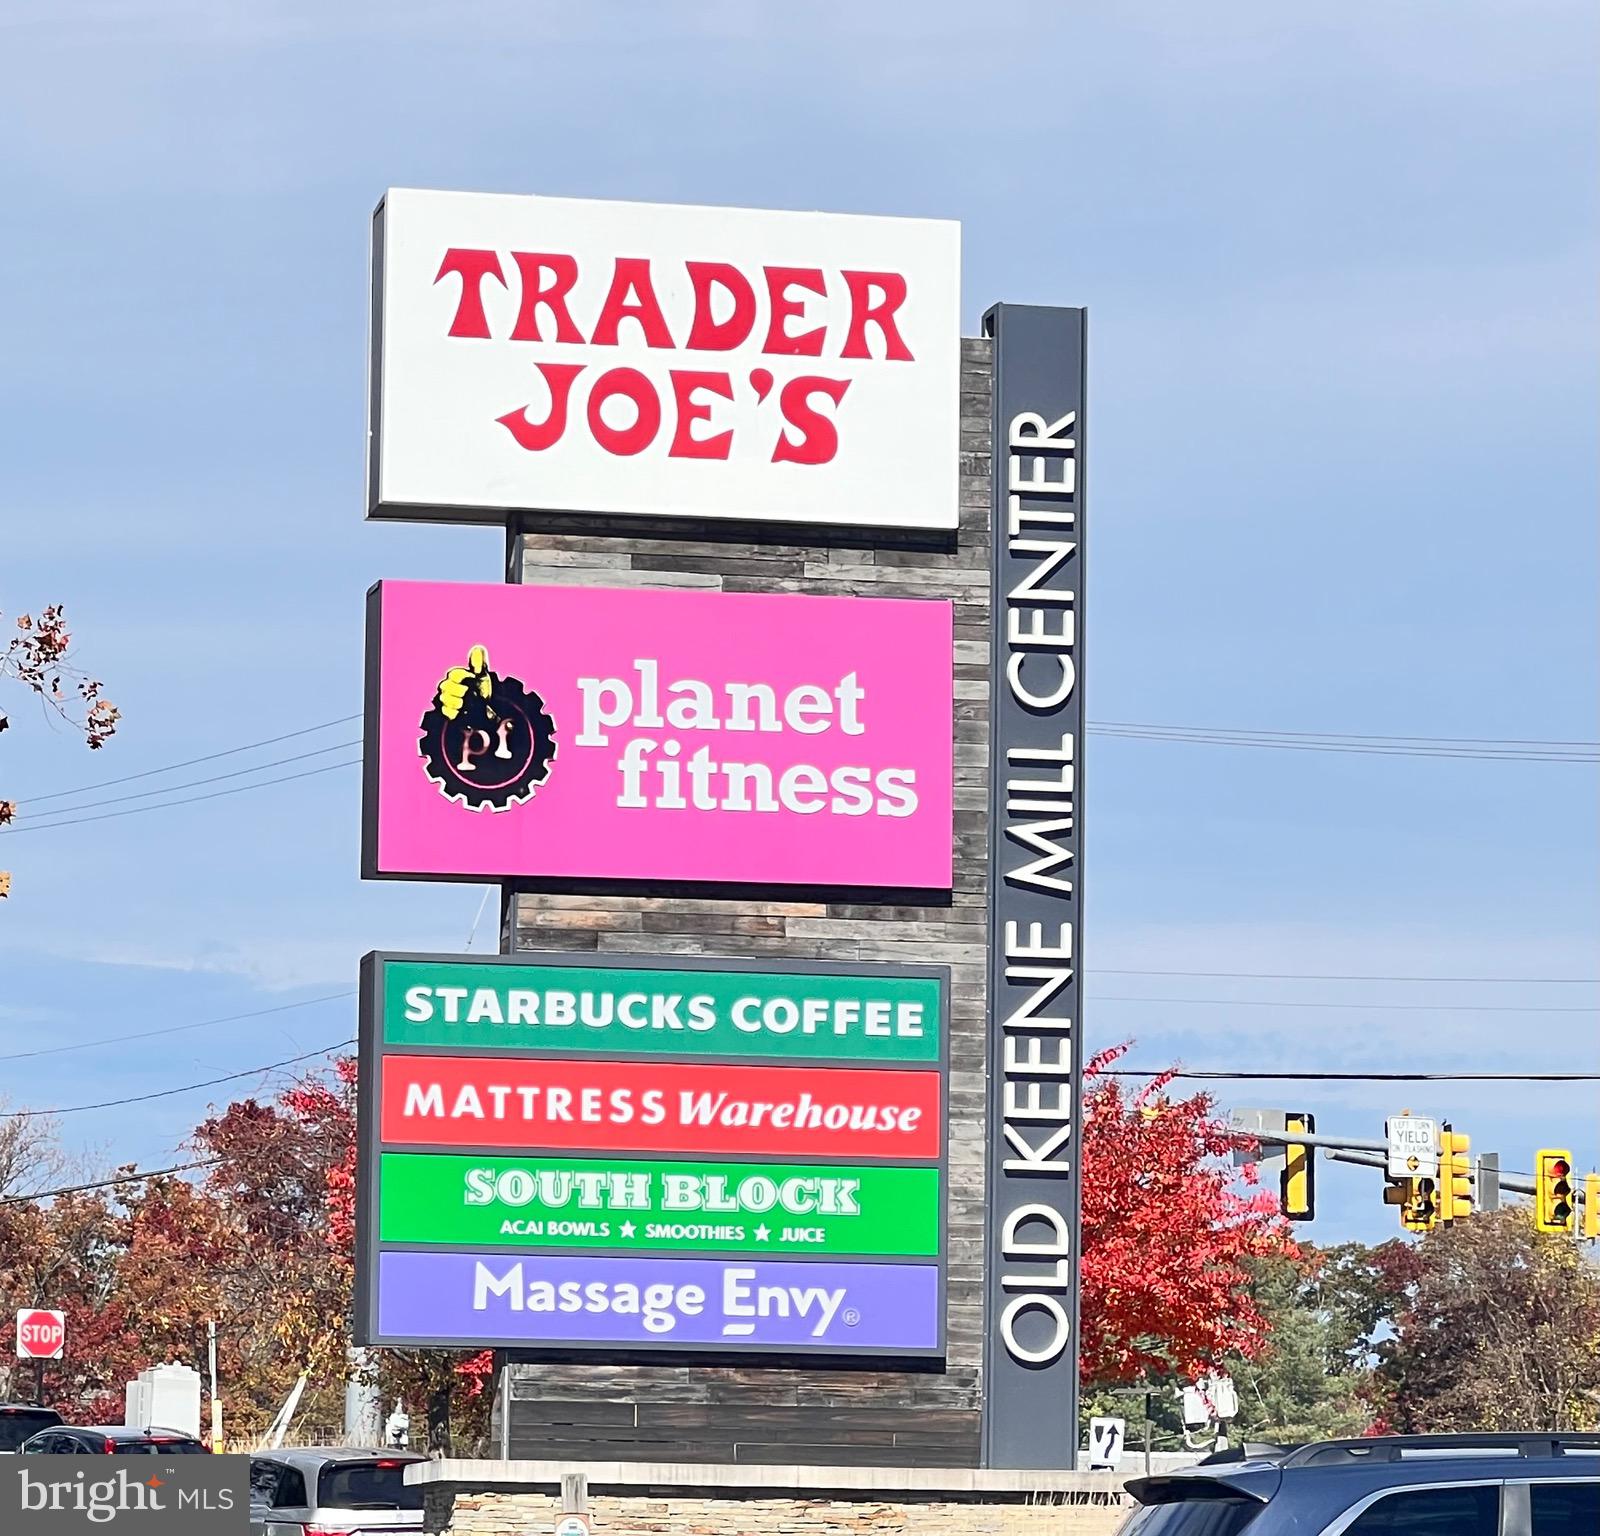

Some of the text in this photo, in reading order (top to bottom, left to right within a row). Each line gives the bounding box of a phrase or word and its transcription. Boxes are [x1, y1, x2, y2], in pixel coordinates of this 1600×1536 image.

[433, 248, 914, 362] TRADER
[495, 363, 854, 465] JOE'S
[575, 658, 865, 747] planet
[616, 738, 919, 818] fitness
[1000, 411, 1077, 1363] OLD KEENE MILL CENTER
[404, 986, 924, 1037] STARBUCKS COFFEE
[403, 1083, 922, 1132] MATTRESS Warehouse
[1397, 1131, 1429, 1144] YIELD
[464, 1167, 861, 1216] SOUTH BLOCK
[500, 1219, 826, 1243] ACAI BOWLS SMOOTHIES JUICE
[473, 1262, 705, 1334] Massage
[21, 1324, 62, 1343] STOP
